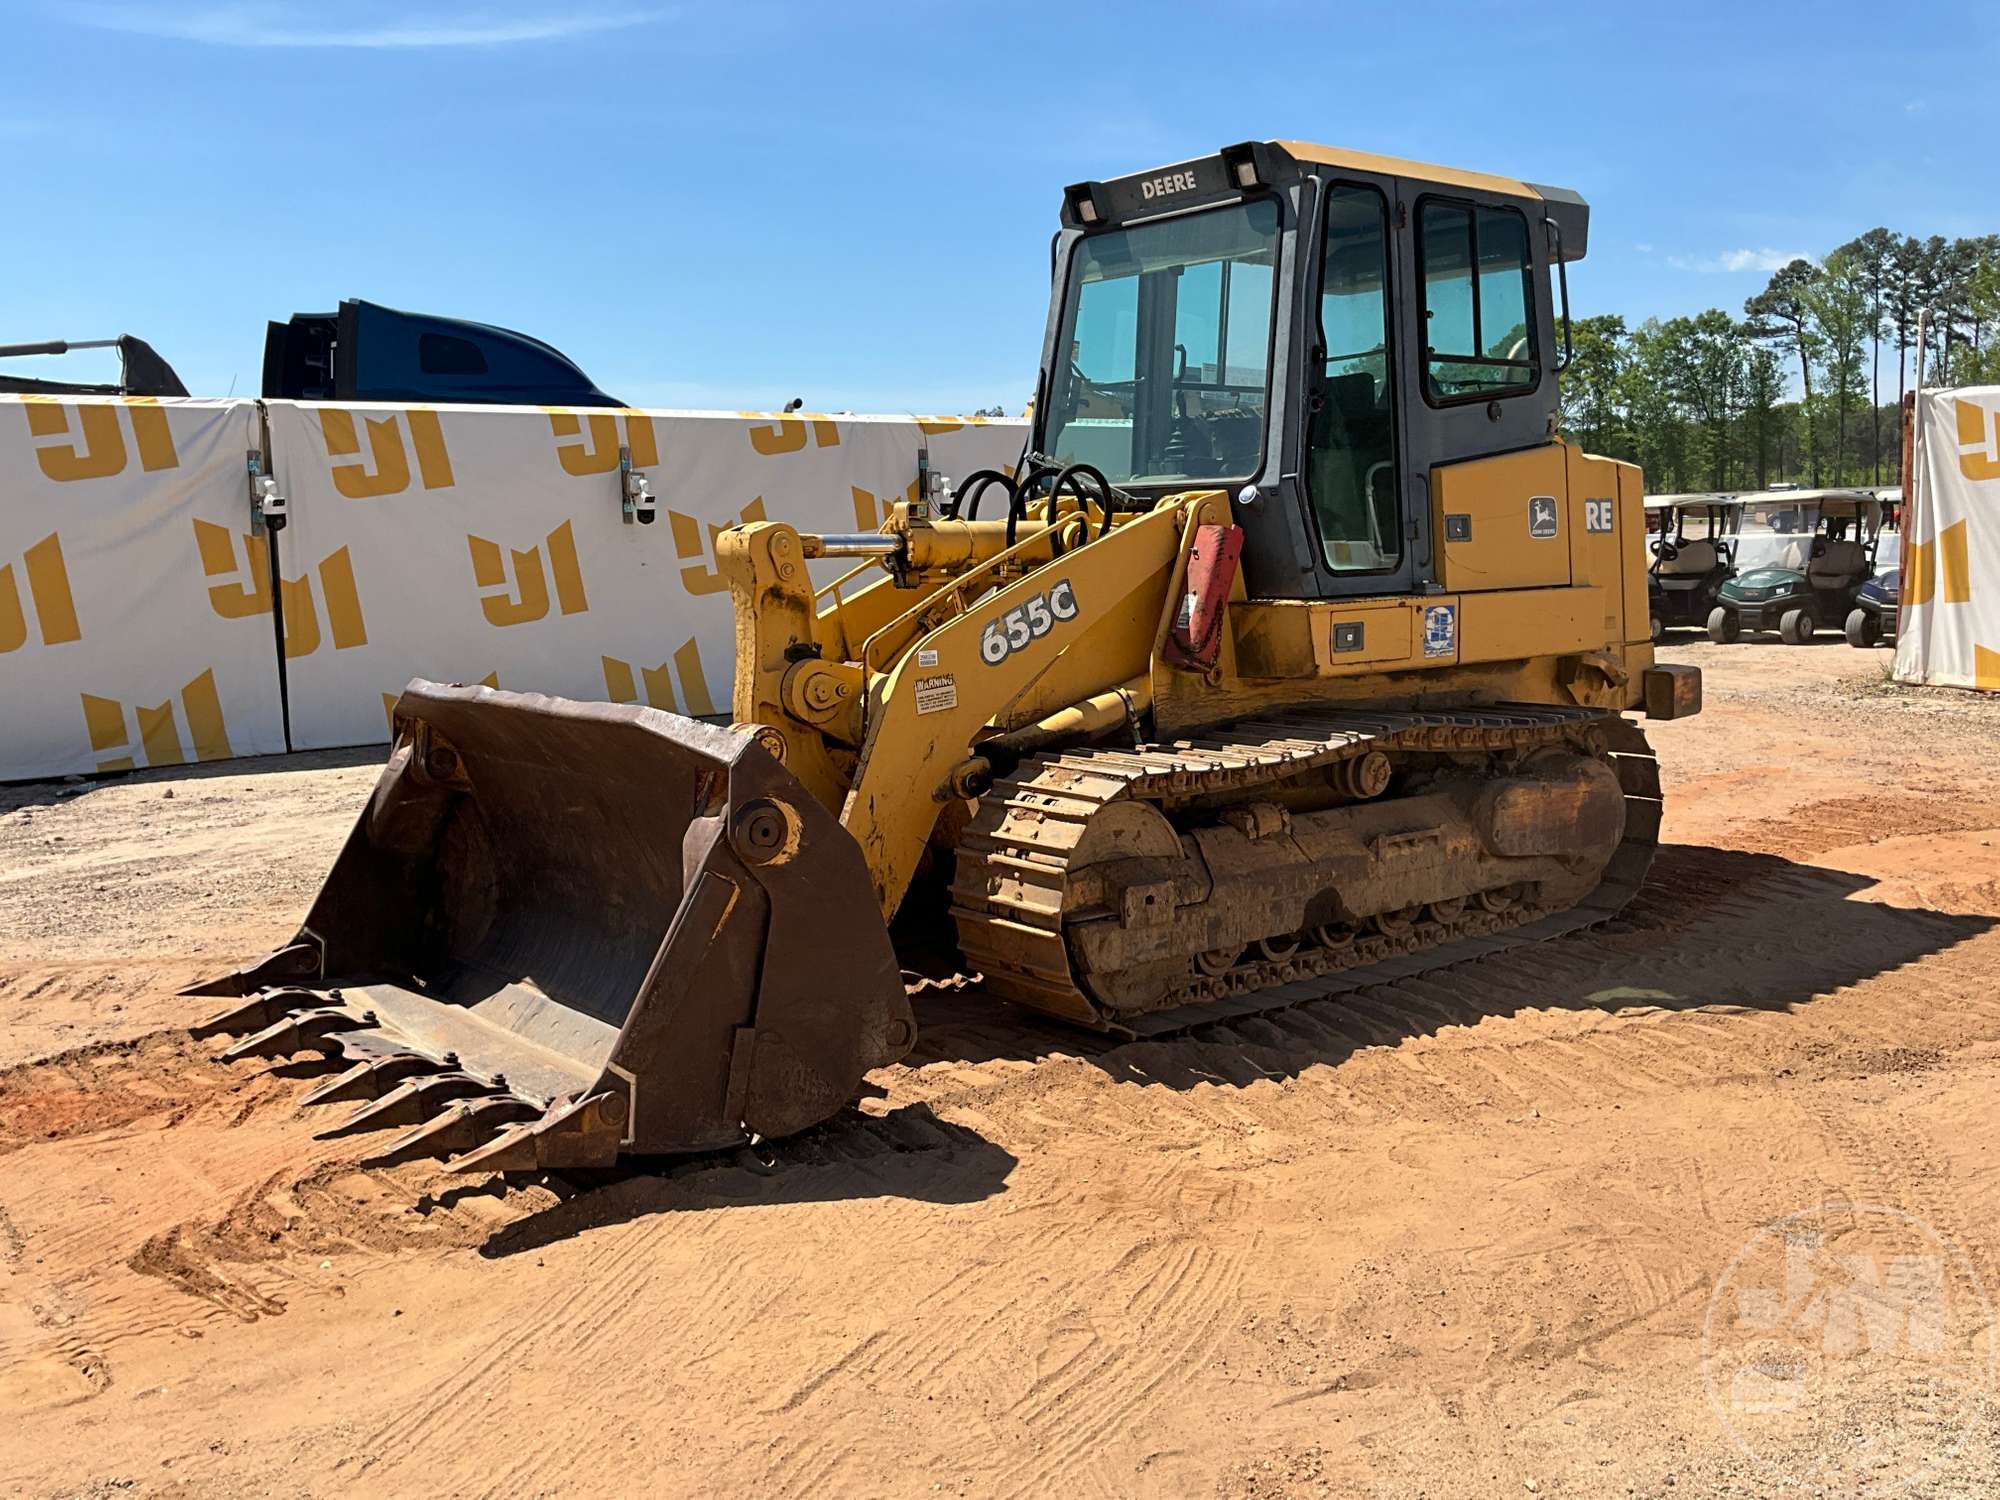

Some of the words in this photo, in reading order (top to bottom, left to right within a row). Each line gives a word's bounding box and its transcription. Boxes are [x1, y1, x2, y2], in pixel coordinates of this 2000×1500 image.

[1141, 171, 1197, 200] DEERE
[1585, 501, 1612, 530] RE
[980, 581, 1078, 664] 655C
[916, 677, 954, 692] WARNING
